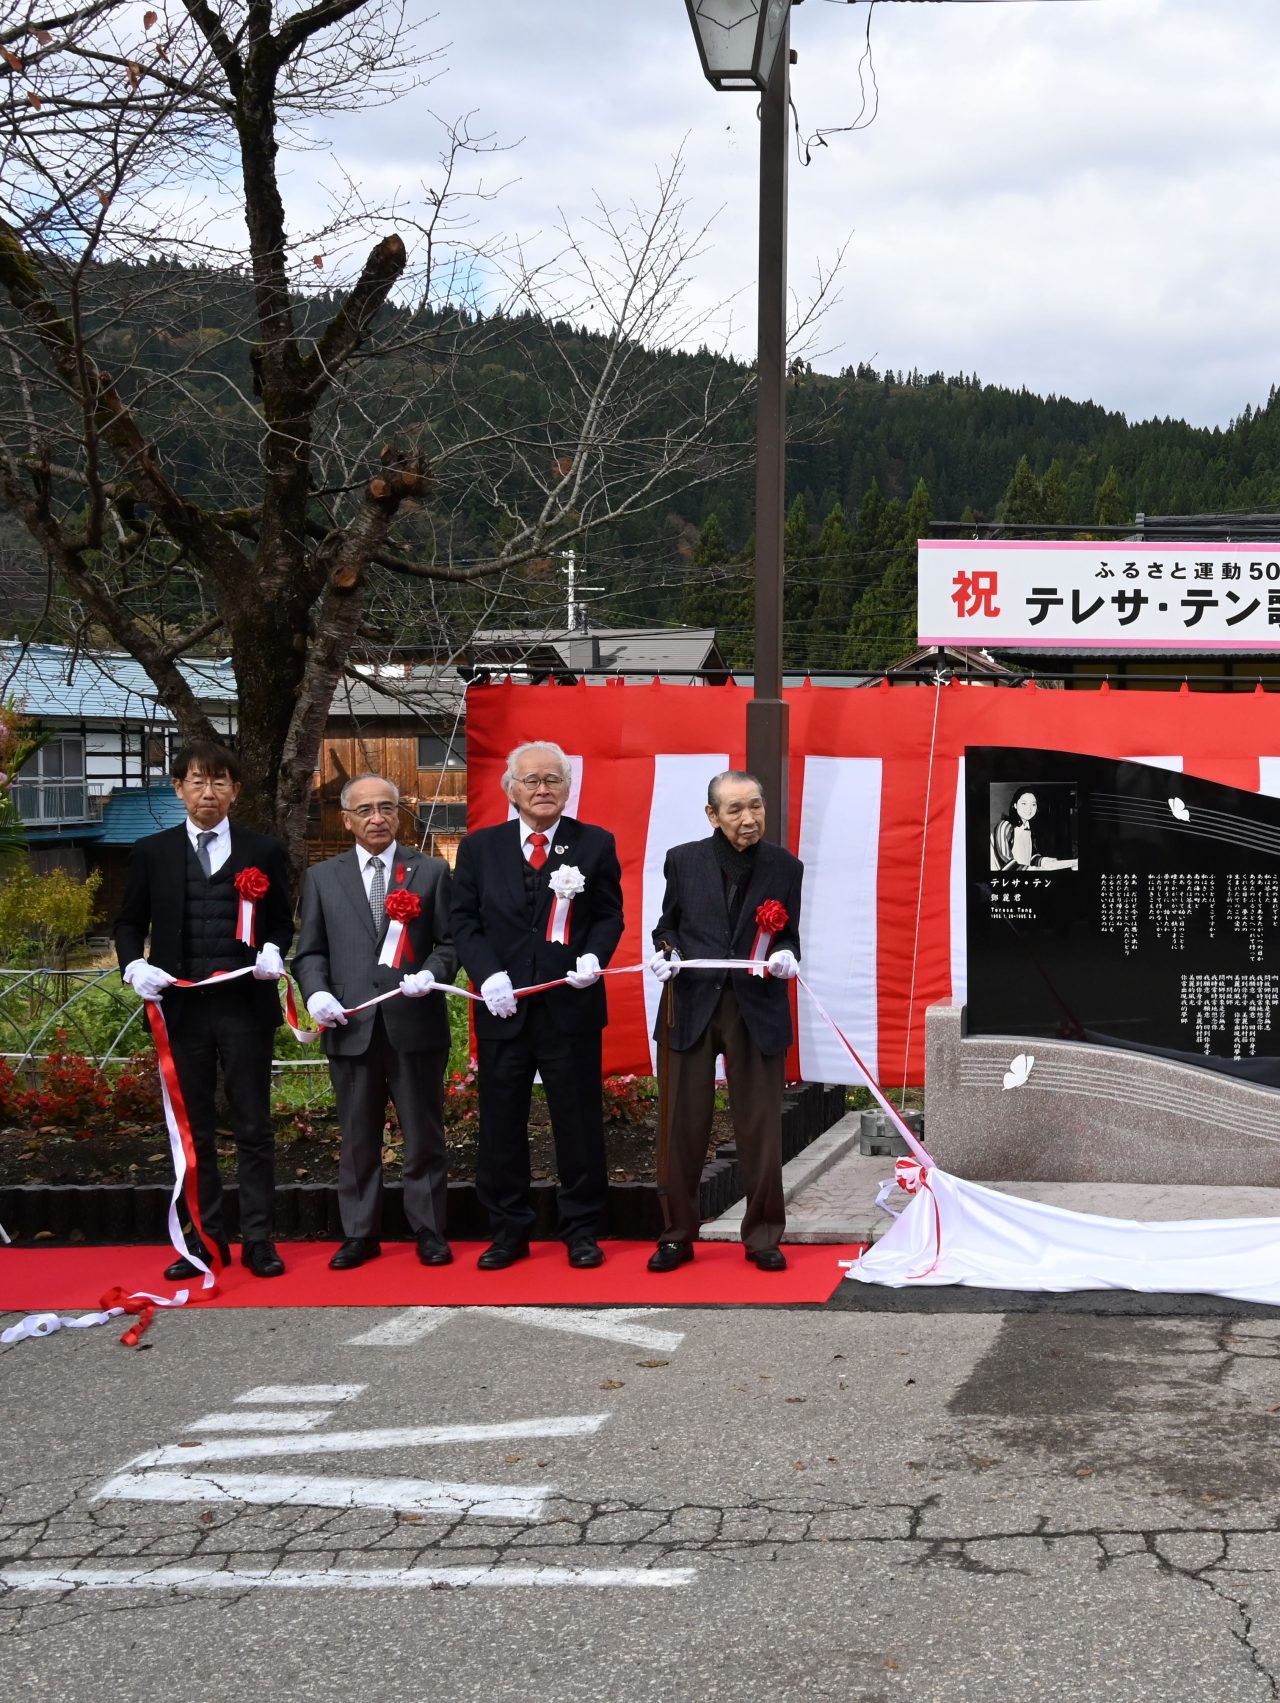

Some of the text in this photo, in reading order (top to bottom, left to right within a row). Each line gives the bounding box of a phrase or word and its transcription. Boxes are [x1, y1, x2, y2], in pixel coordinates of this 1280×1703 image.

[951, 570, 1000, 619] 祝
[990, 878, 1052, 888] テレサ・テン
